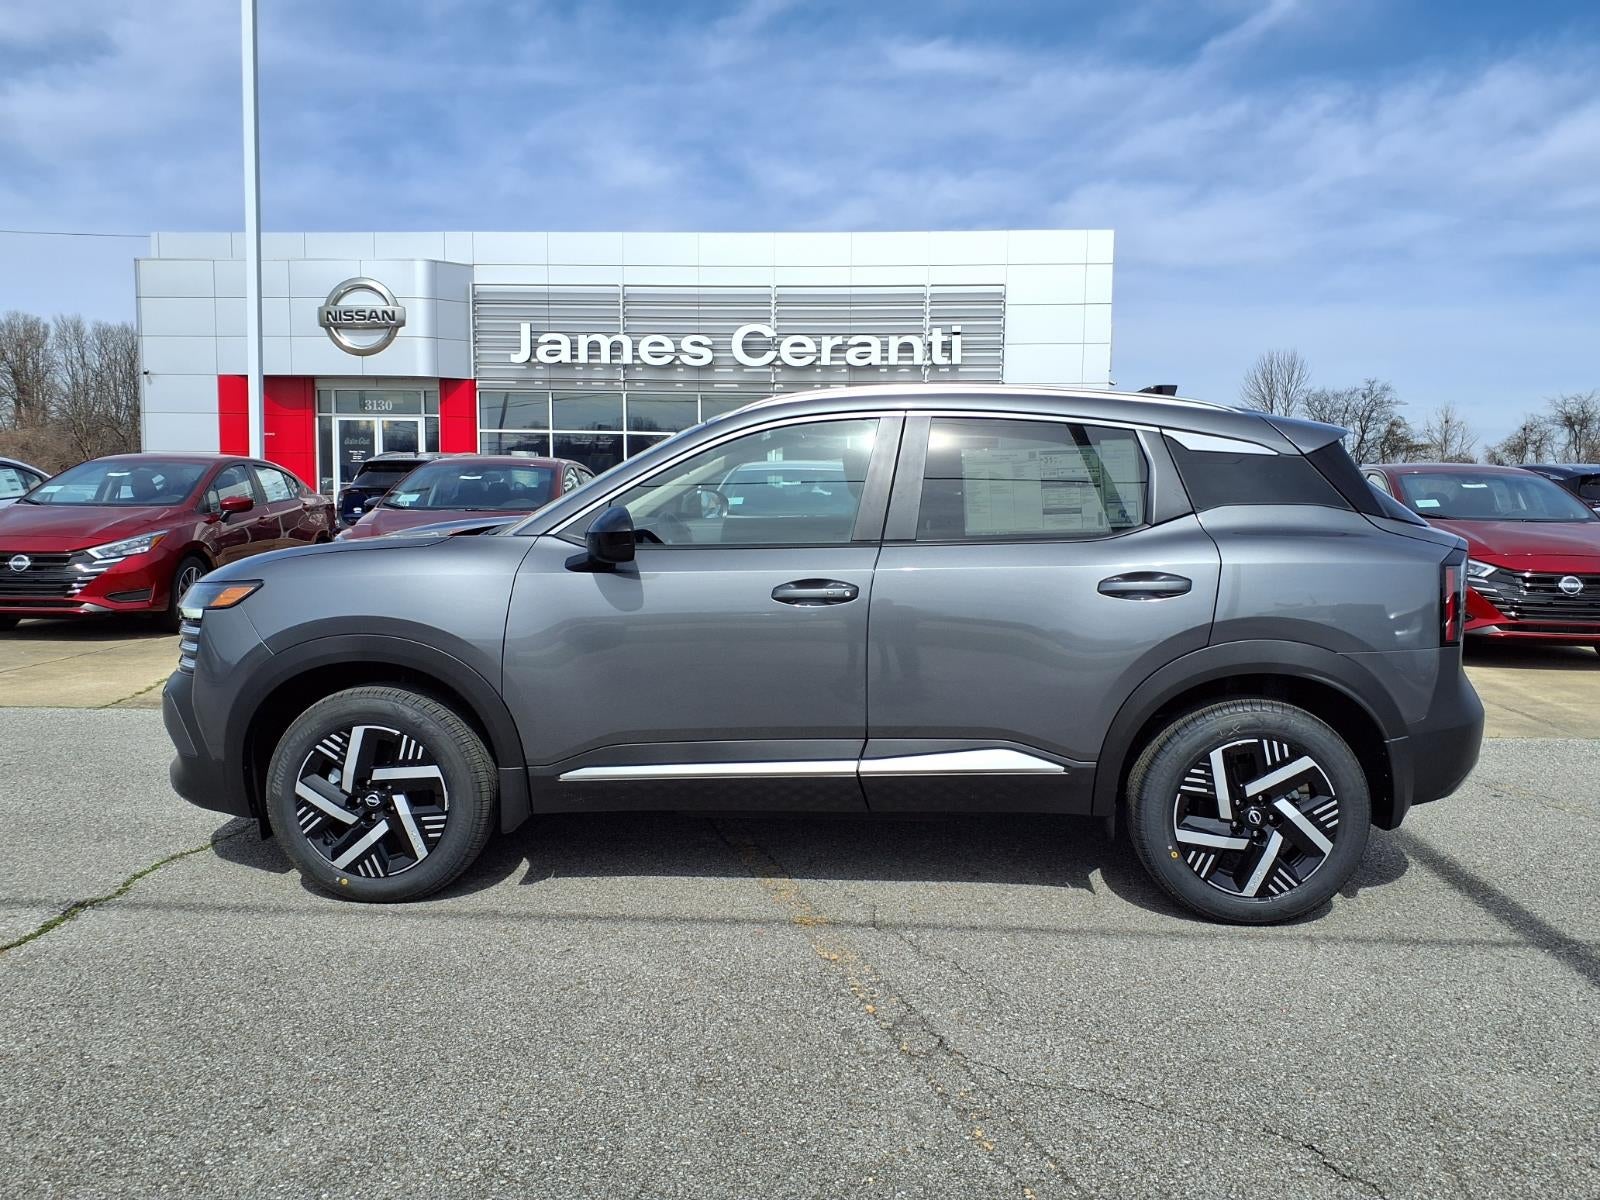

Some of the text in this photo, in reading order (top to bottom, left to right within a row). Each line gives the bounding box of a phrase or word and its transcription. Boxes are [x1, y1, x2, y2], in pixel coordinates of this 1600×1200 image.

[325, 309, 396, 322] NISSAN
[510, 322, 962, 367] James Ceranti
[364, 400, 393, 411] 3130
